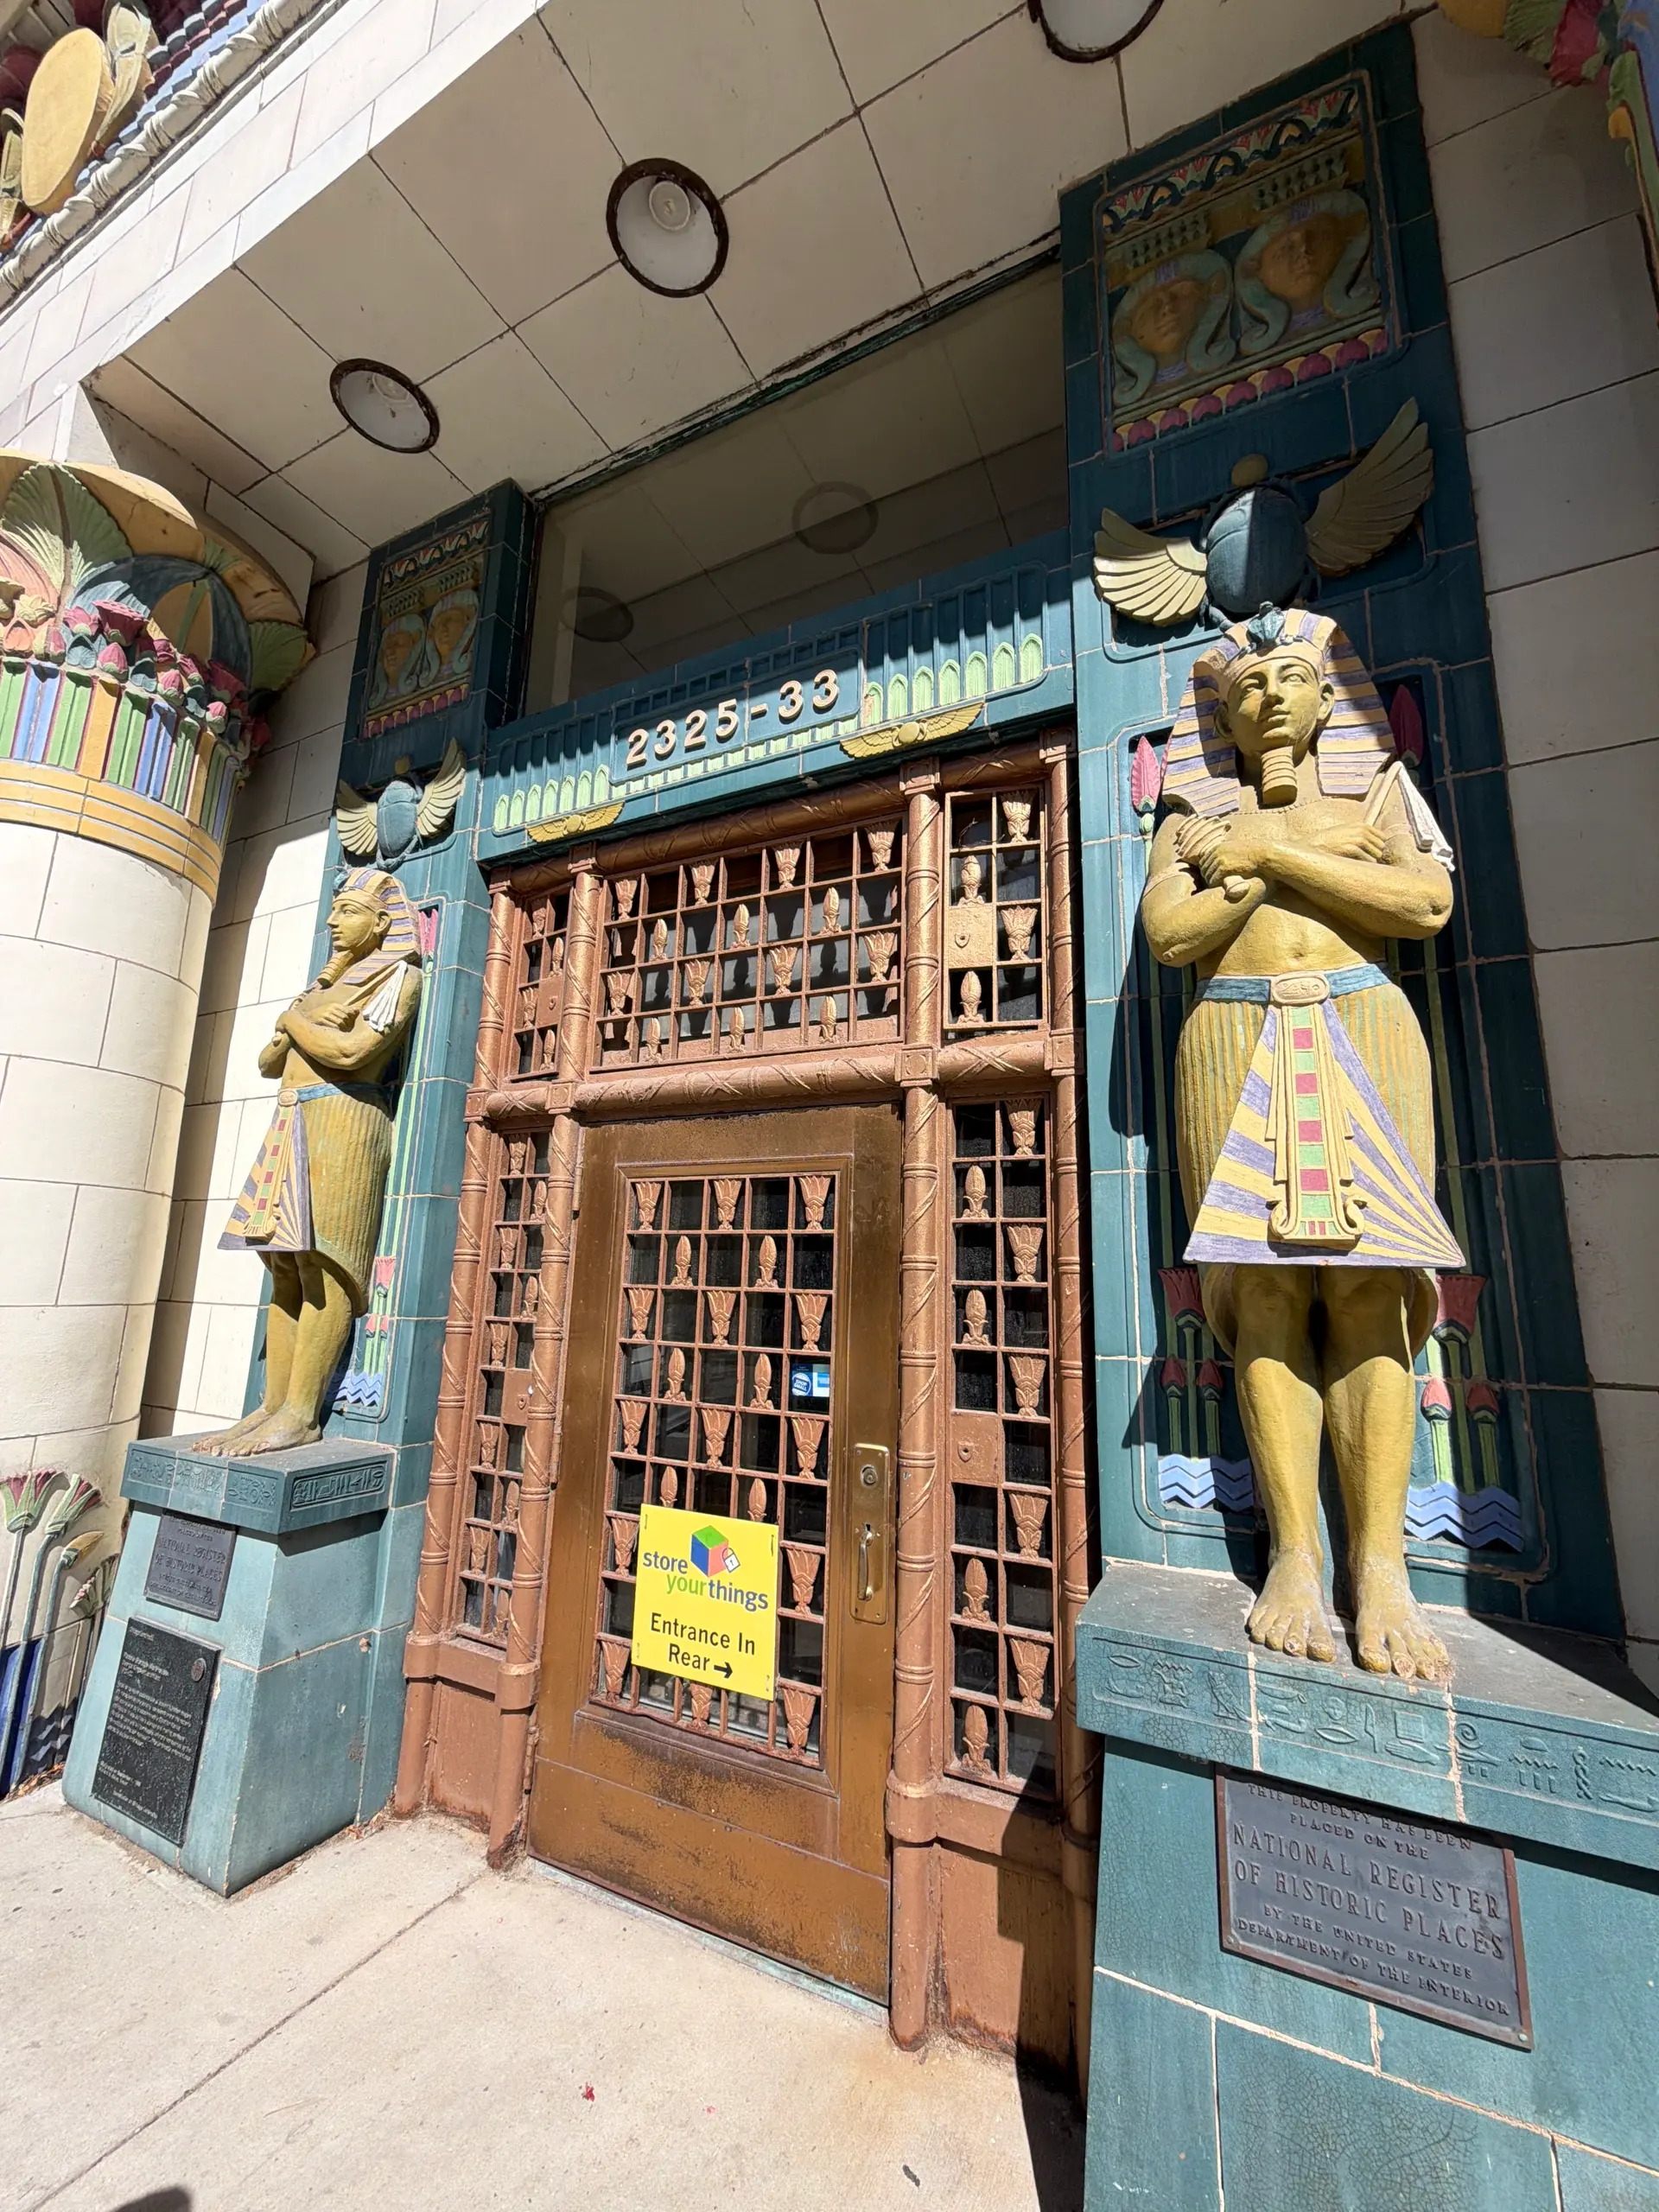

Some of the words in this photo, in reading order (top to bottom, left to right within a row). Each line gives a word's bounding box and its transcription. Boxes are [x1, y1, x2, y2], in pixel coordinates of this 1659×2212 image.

[626, 669, 840, 768] 2325-33
[643, 1551, 688, 1574] store
[666, 1574, 706, 1596] your
[709, 1581, 768, 1612] things
[651, 1612, 730, 1649] Entrance
[738, 1632, 755, 1656] In
[669, 1643, 710, 1671] Rear
[1248, 1783, 1283, 1802] THIS
[1292, 1794, 1372, 1825] PROPERTY
[1381, 1818, 1416, 1836] HAS
[1424, 1828, 1472, 1851] BEEN
[1289, 1812, 1355, 1840] PLACED
[1363, 1831, 1389, 1849] ON
[1394, 1840, 1429, 1860] THE
[1233, 1821, 1351, 1876] NATIONAL
[1370, 1860, 1502, 1919] REGISTER
[1235, 1858, 1262, 1885] OF
[1275, 1869, 1388, 1923] HISTORIC
[1402, 1906, 1505, 1961] PLACES
[1263, 1904, 1284, 1920] BY
[1292, 1913, 1324, 1933] THE
[1332, 1925, 1397, 1956] UNITED
[1408, 1949, 1474, 1980] STATES
[1237, 1917, 1343, 1961] DEPARTMENT
[1349, 1953, 1370, 1970] OF
[1377, 1961, 1410, 1985] THE
[1418, 1976, 1510, 2016] INTERIOR
